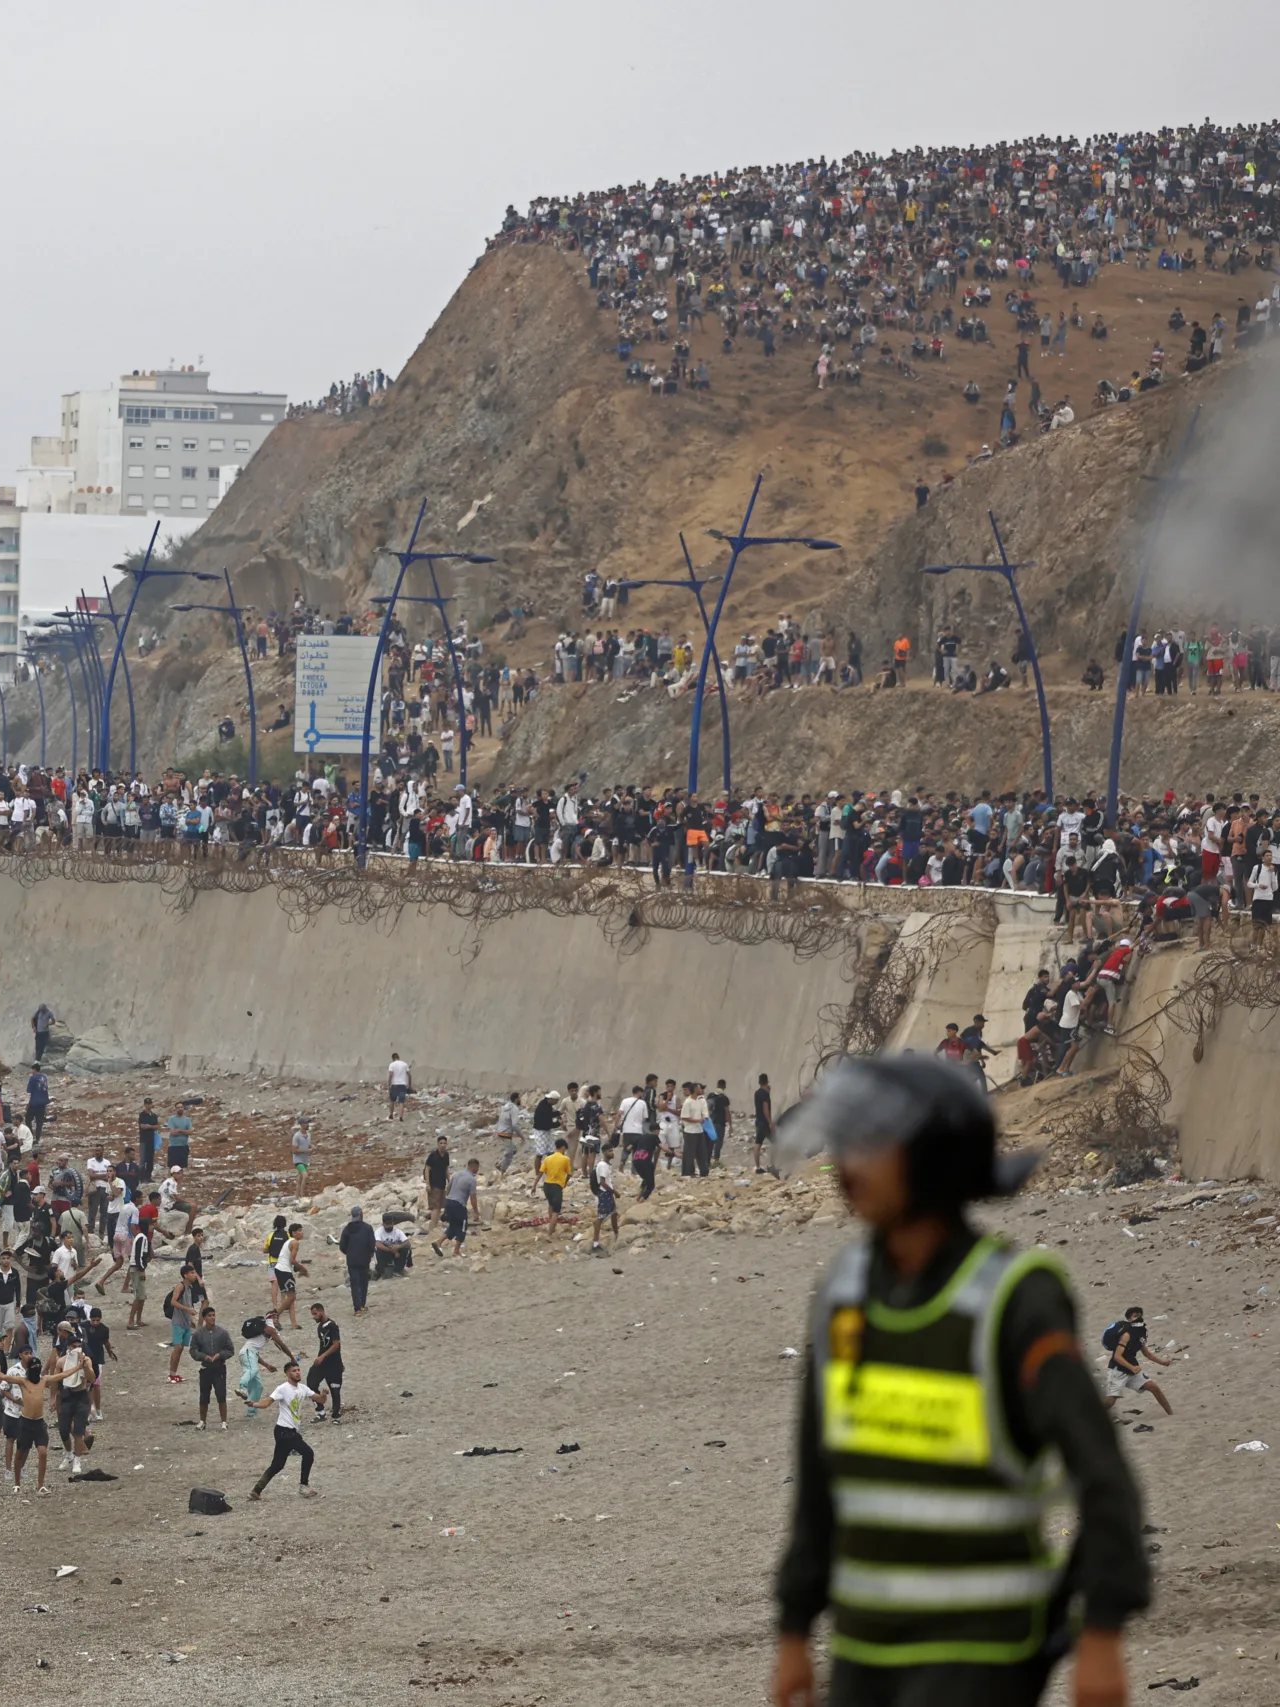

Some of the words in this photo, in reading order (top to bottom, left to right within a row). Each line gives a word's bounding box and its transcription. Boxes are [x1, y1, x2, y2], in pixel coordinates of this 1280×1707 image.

[300, 651, 328, 661] تطوان
[303, 662, 325, 672] الرباط
[344, 723, 364, 731] TANGE
